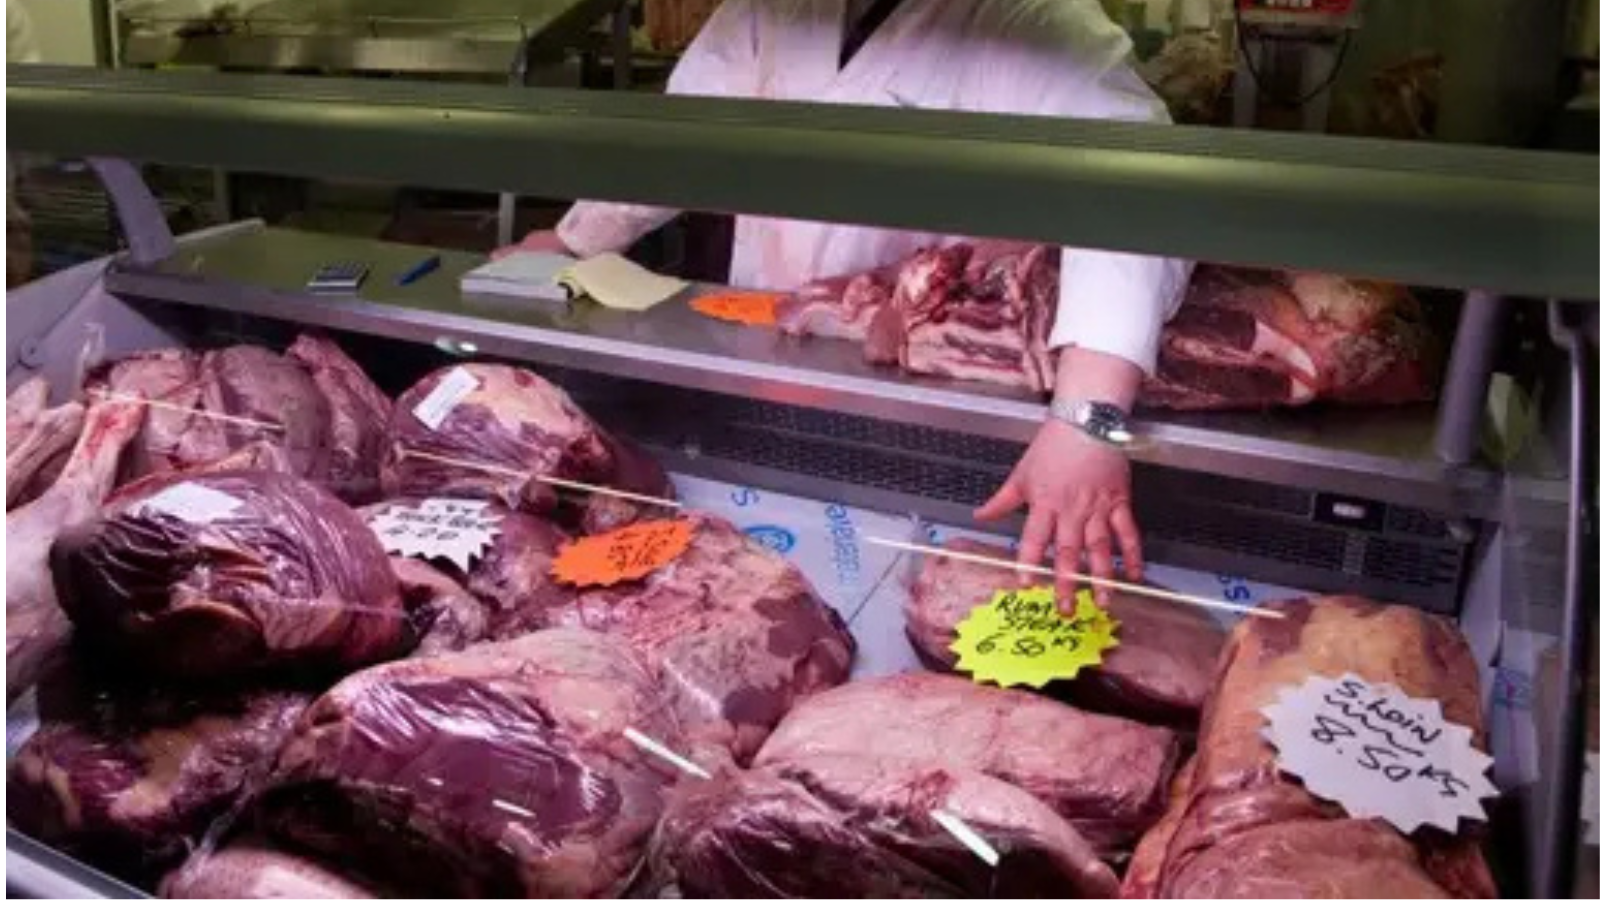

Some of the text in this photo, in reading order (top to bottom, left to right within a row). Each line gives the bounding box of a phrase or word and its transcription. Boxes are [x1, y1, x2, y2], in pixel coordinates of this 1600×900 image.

[995, 592, 1053, 617] RUM
[976, 632, 1046, 658] 6.50
[1311, 714, 1412, 782] 8.50
